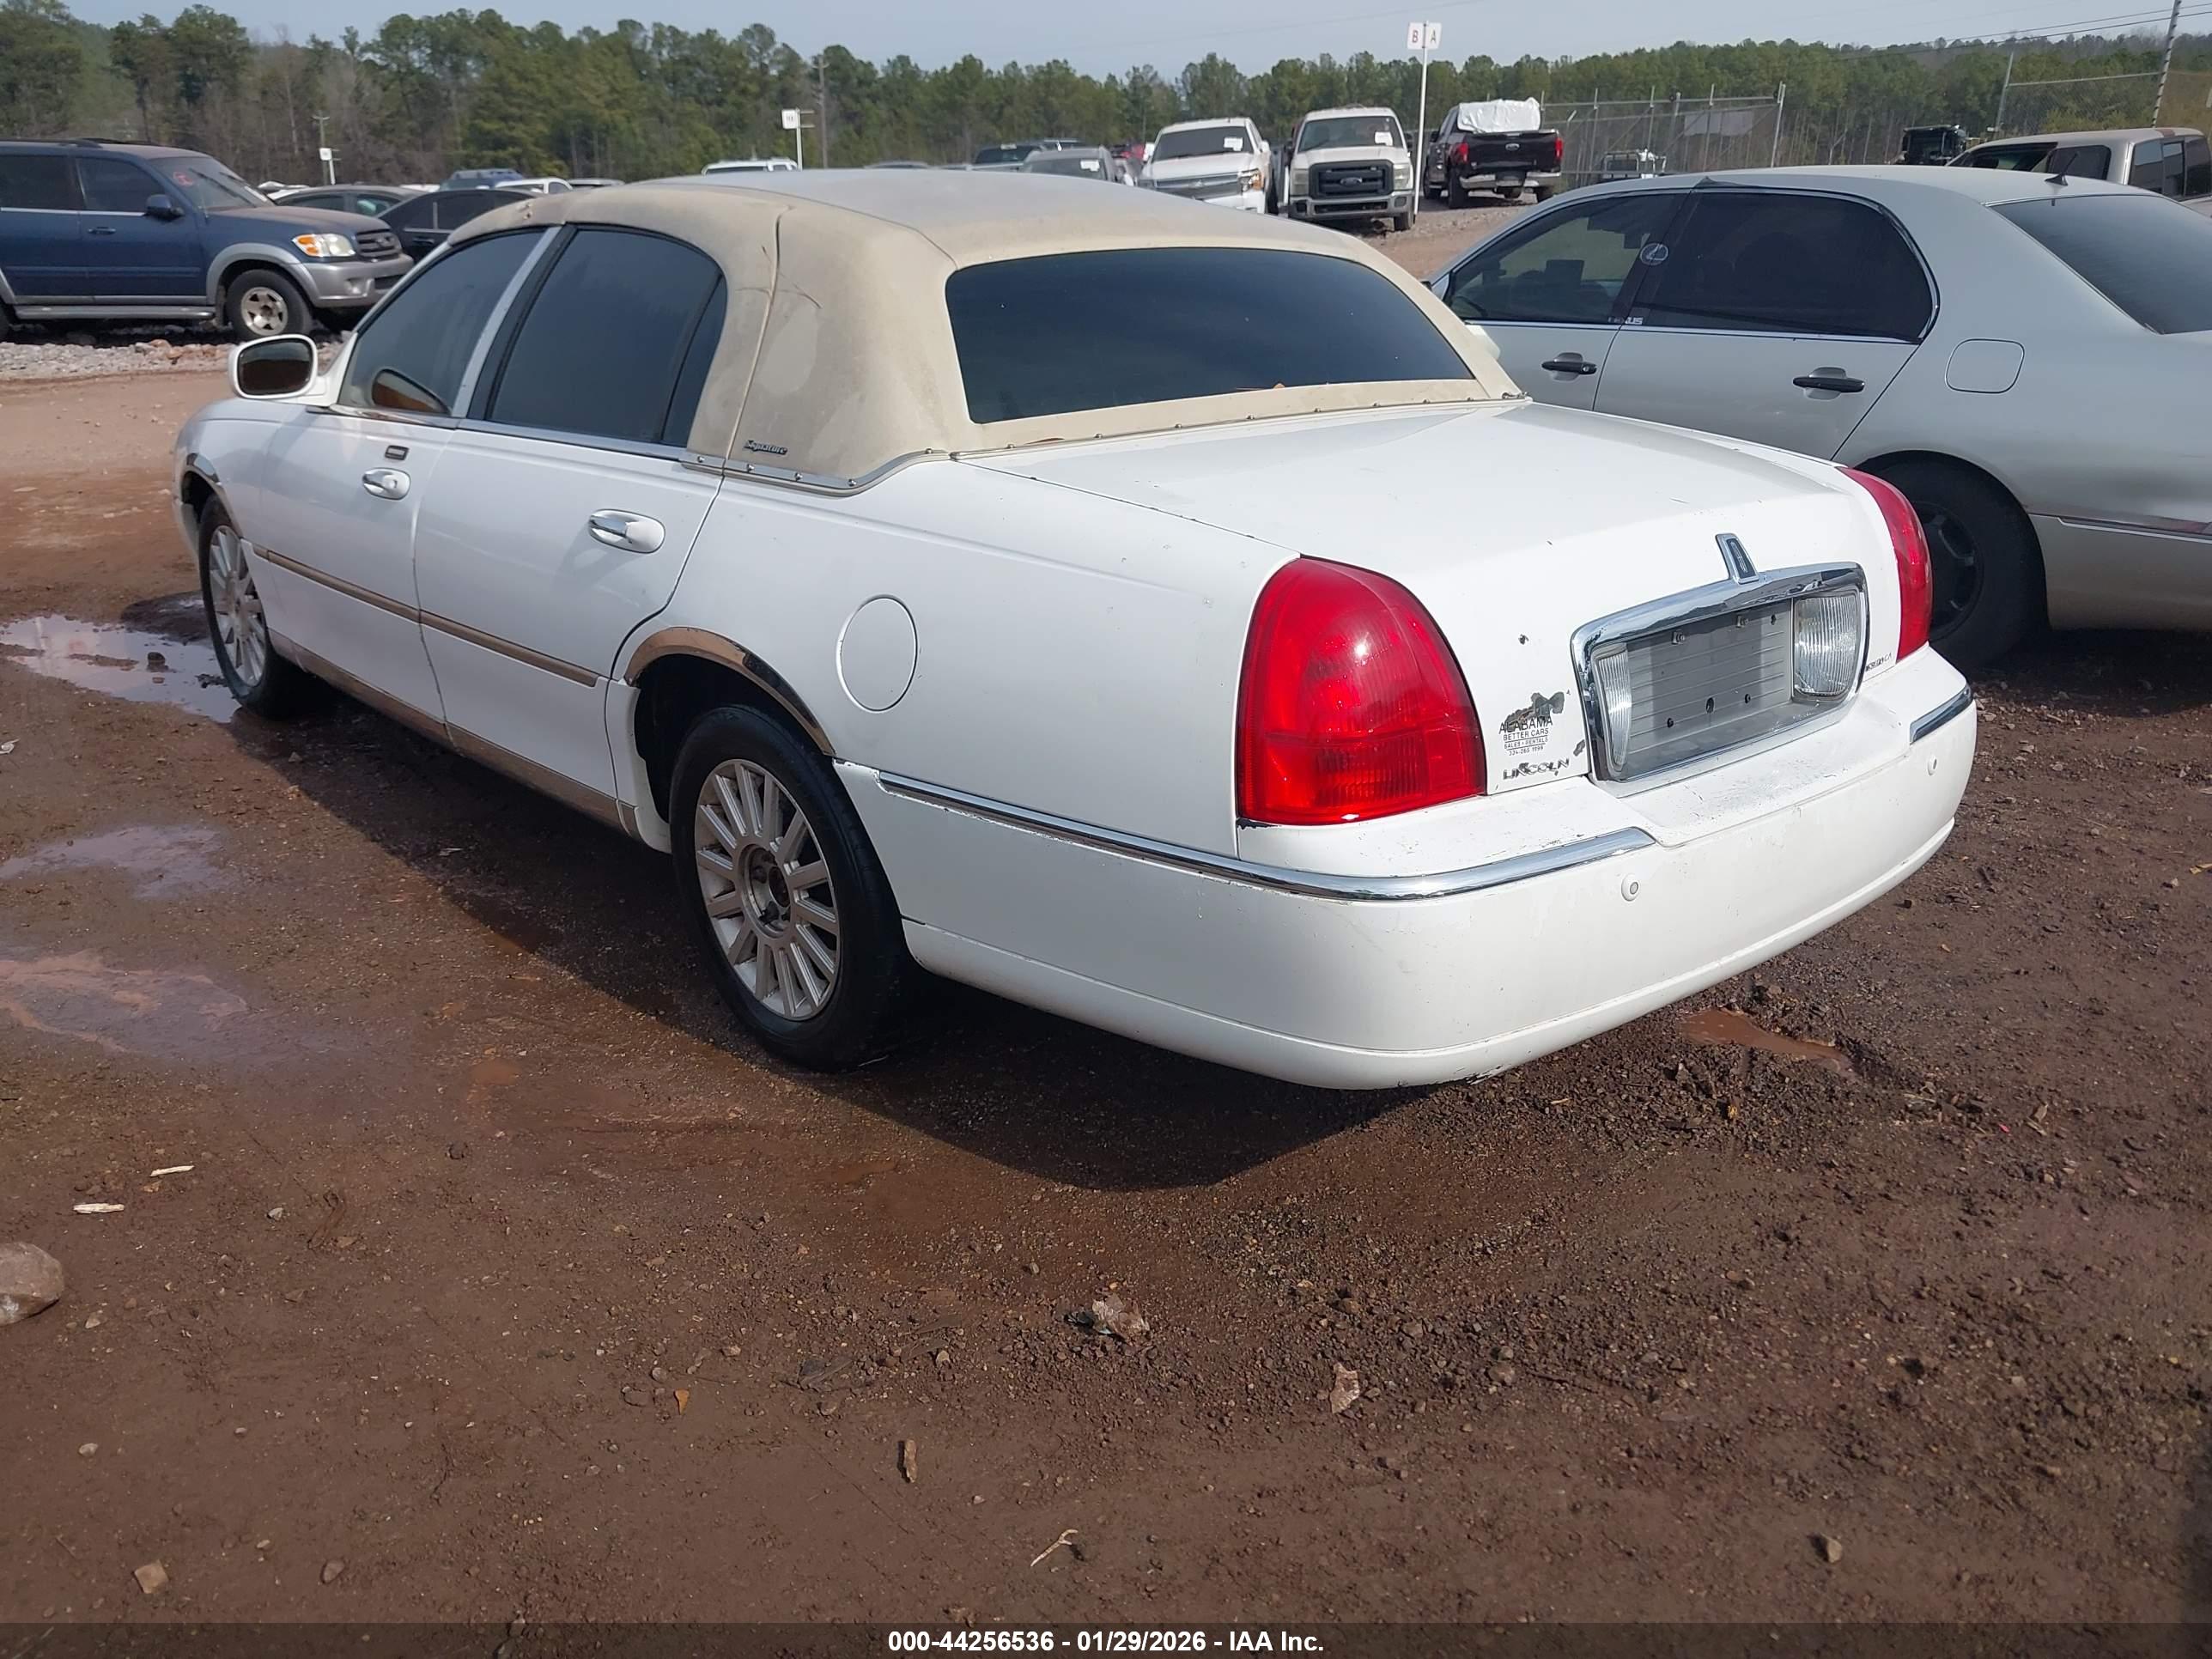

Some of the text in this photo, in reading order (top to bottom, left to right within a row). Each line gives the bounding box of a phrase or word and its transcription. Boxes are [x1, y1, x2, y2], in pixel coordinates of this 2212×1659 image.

[1412, 30, 1419, 43] B
[1430, 29, 1437, 44] A
[1498, 715, 1553, 734] ALABAMA
[1503, 728, 1549, 741] BETTER CARS
[1503, 758, 1570, 780] LINCOLN
